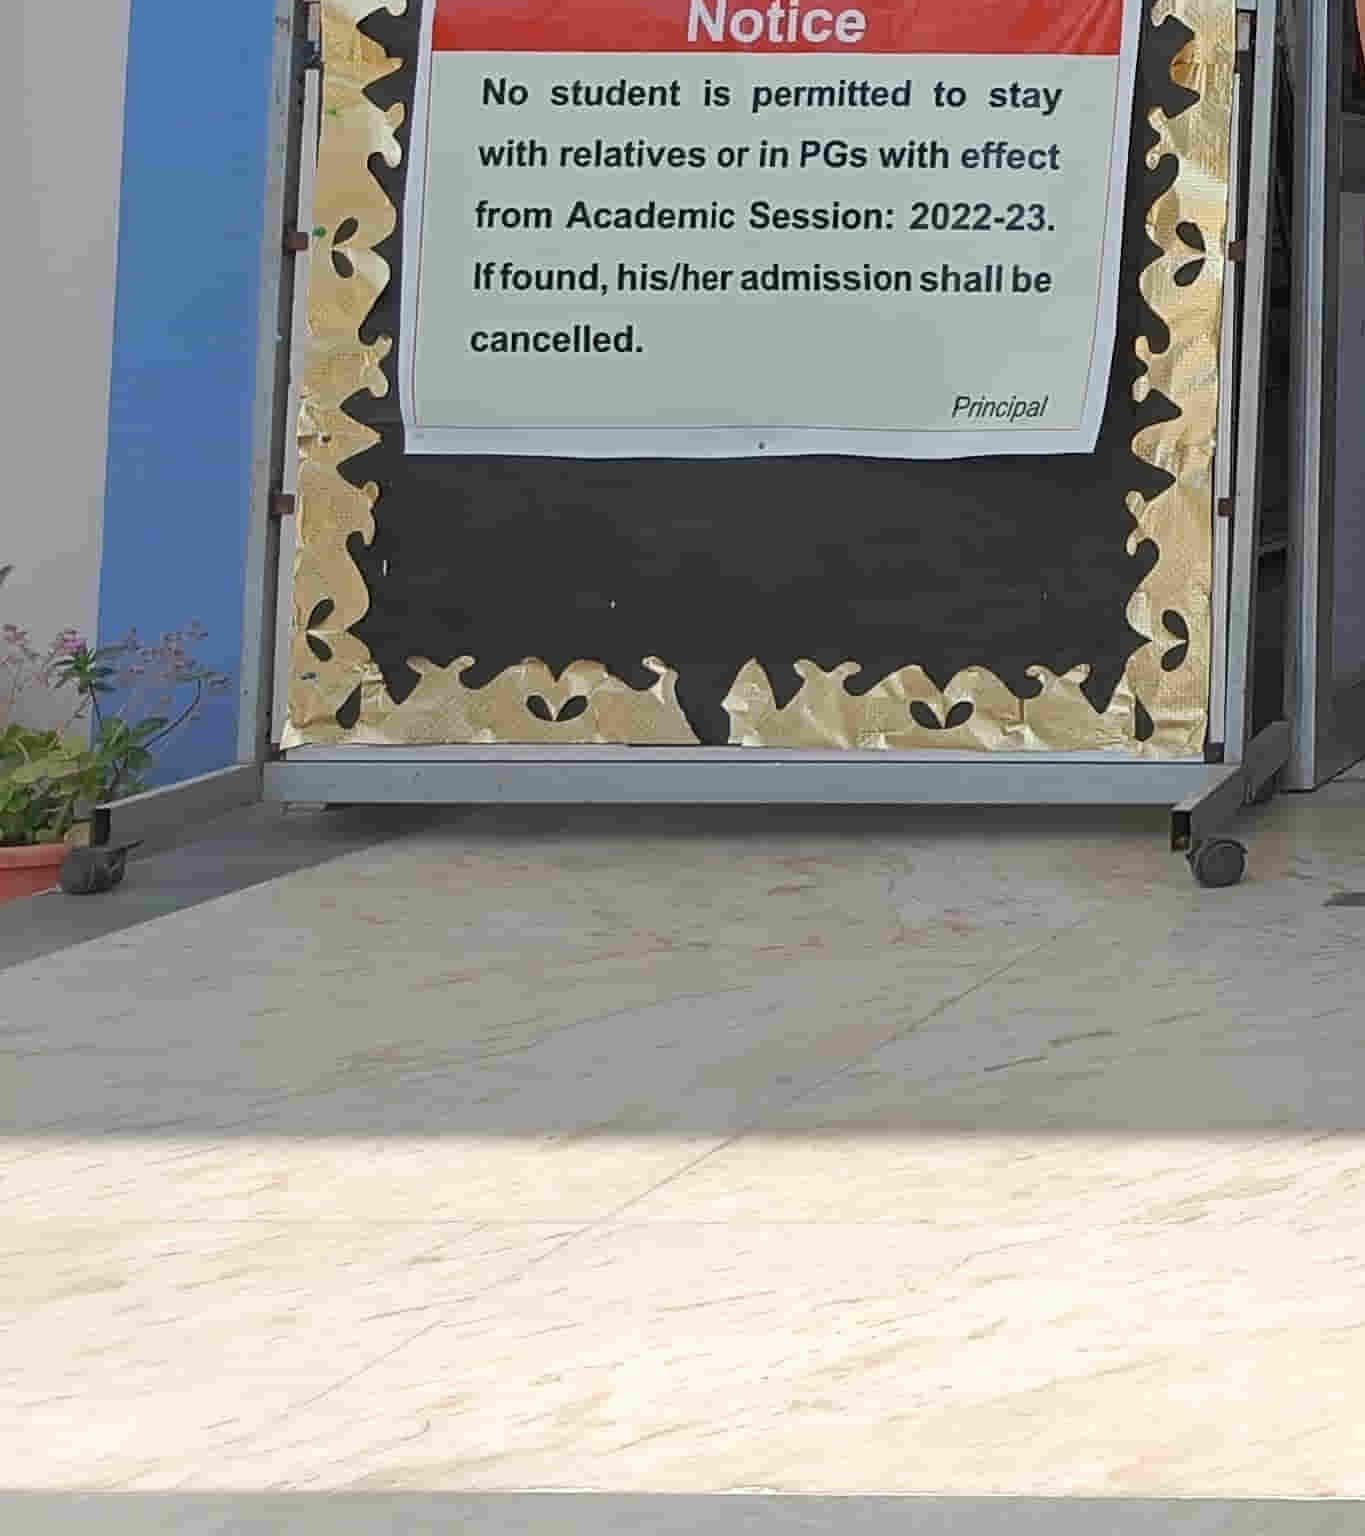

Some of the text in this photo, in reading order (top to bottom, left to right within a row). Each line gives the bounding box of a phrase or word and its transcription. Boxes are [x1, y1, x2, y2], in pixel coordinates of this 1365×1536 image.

[483, 78, 1062, 116] No student is permitted to stay
[479, 140, 1060, 170] with relatives or in PGs with effect
[476, 200, 1054, 231] from Academic Session: 2022-23.
[475, 262, 1051, 296] If found, his/her admission shall be
[471, 325, 642, 352] cancelled.
[952, 395, 1048, 423] Principal
